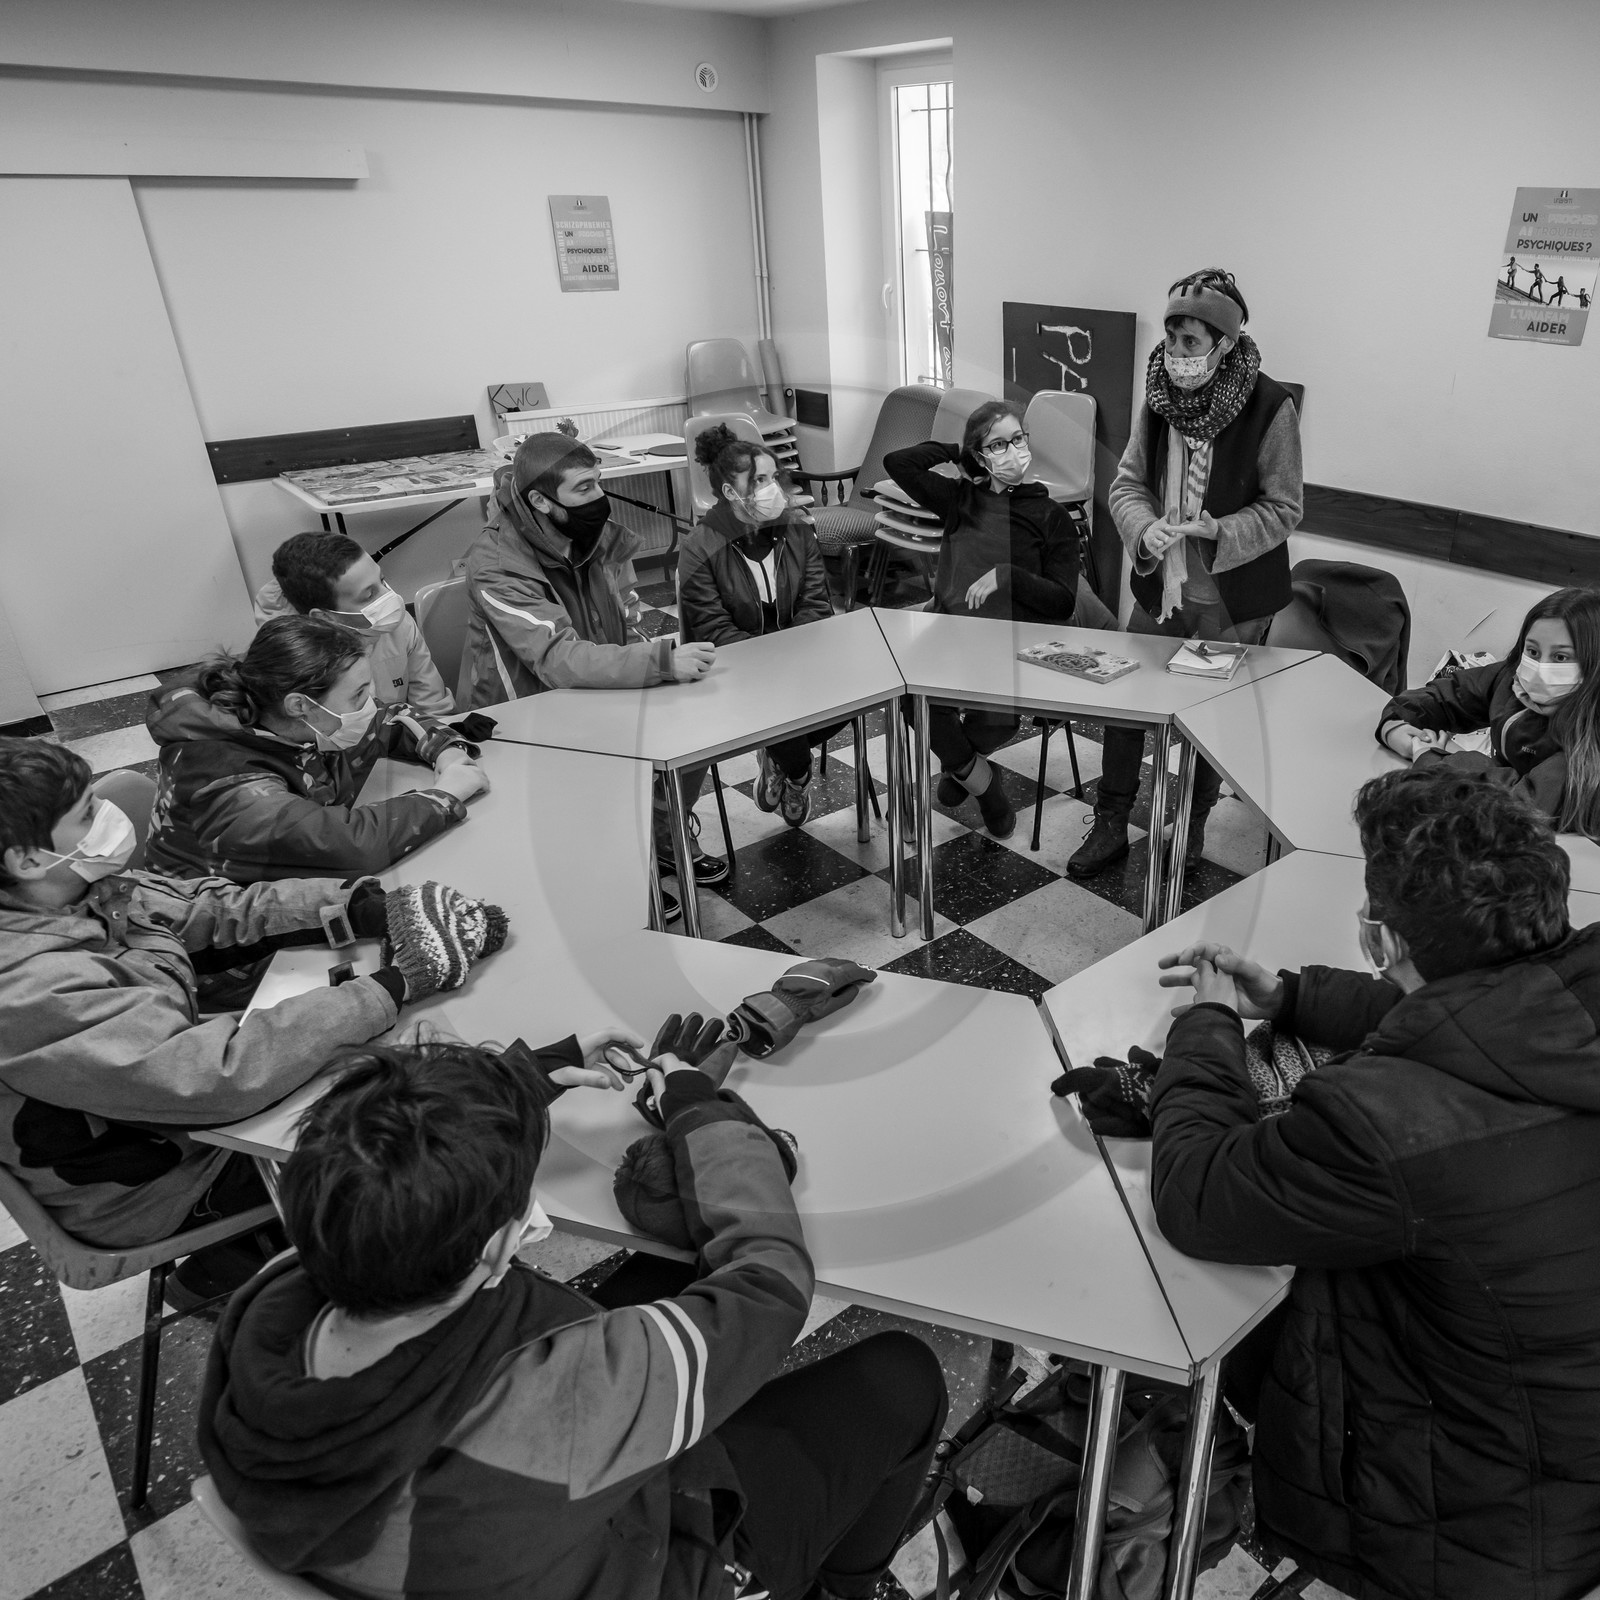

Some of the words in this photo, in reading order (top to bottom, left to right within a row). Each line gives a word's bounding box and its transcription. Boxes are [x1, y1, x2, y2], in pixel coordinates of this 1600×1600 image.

[1522, 212, 1539, 223] UN
[1510, 308, 1570, 323] L'UNAFAM
[1526, 321, 1567, 335] AIDER
